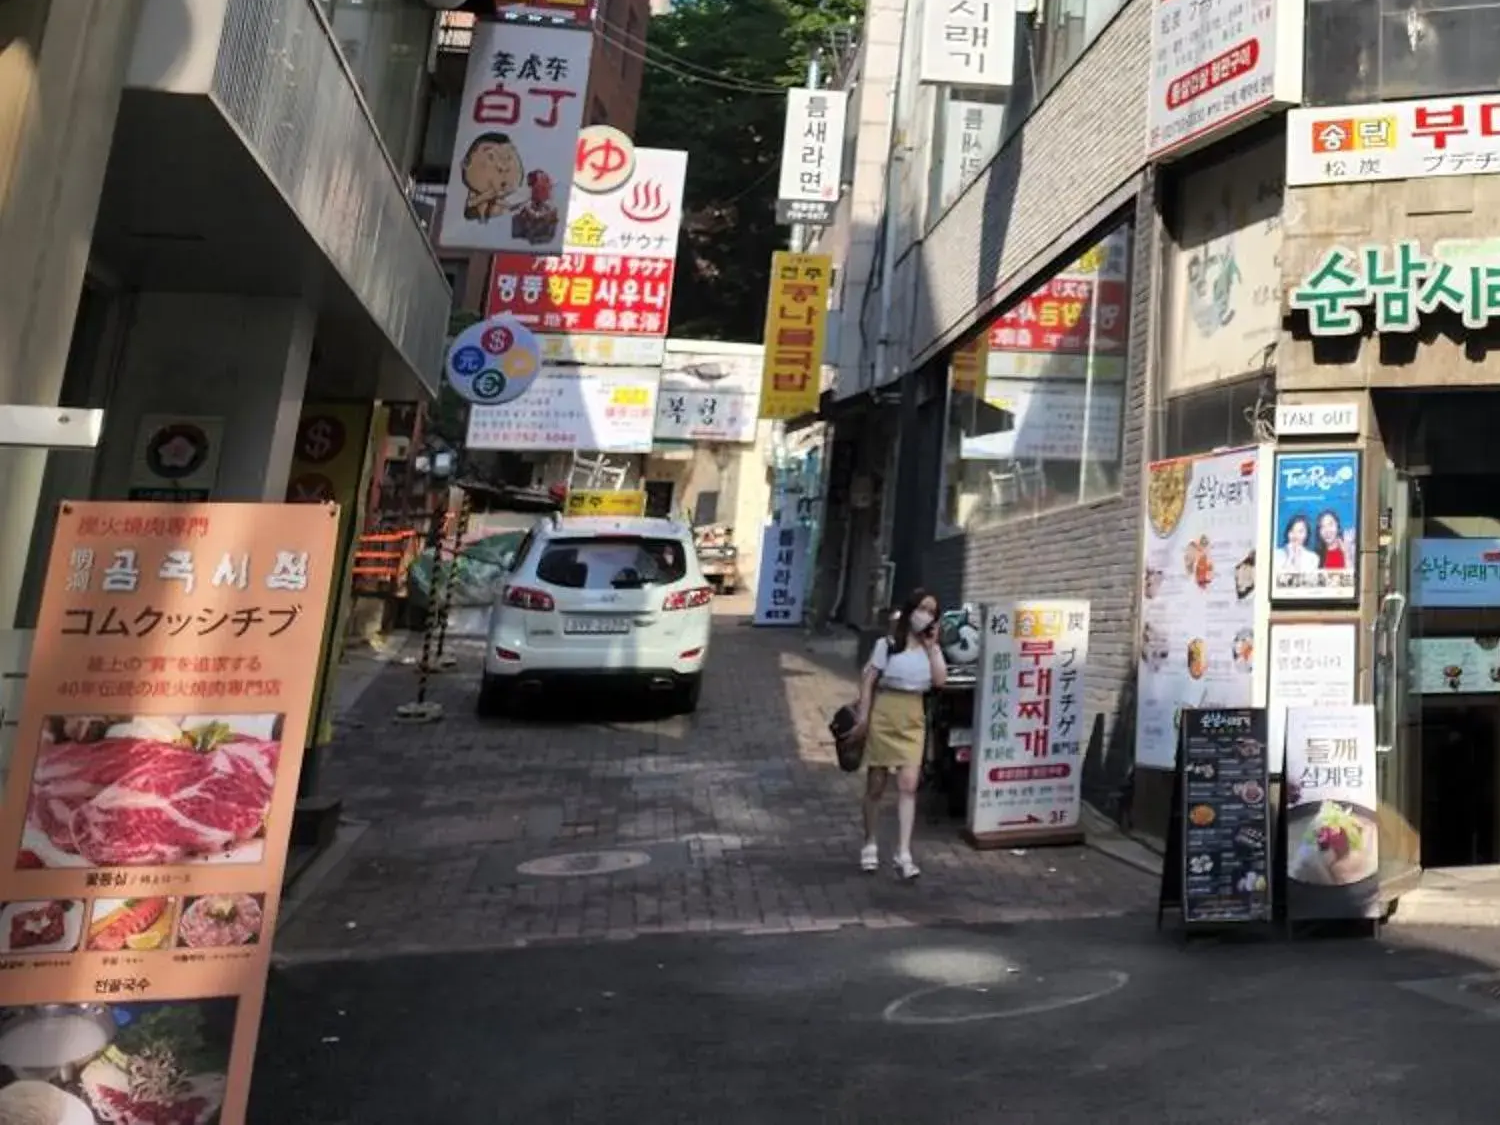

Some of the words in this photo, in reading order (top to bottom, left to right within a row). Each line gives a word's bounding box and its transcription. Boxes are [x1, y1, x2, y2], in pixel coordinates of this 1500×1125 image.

[473, 86, 576, 128] 白丁
[800, 96, 828, 194] 틈새라면
[1316, 119, 1393, 150] 송탄
[576, 135, 627, 180] ゆ
[1324, 158, 1382, 176] 松炭
[1323, 409, 1352, 426] OUT
[102, 548, 308, 594] 곰국시집
[61, 605, 303, 638] コムクッシチブ
[1015, 640, 1056, 758] 부대찌개
[1305, 738, 1359, 764] 들깨
[1300, 766, 1363, 789] 삼계탕
